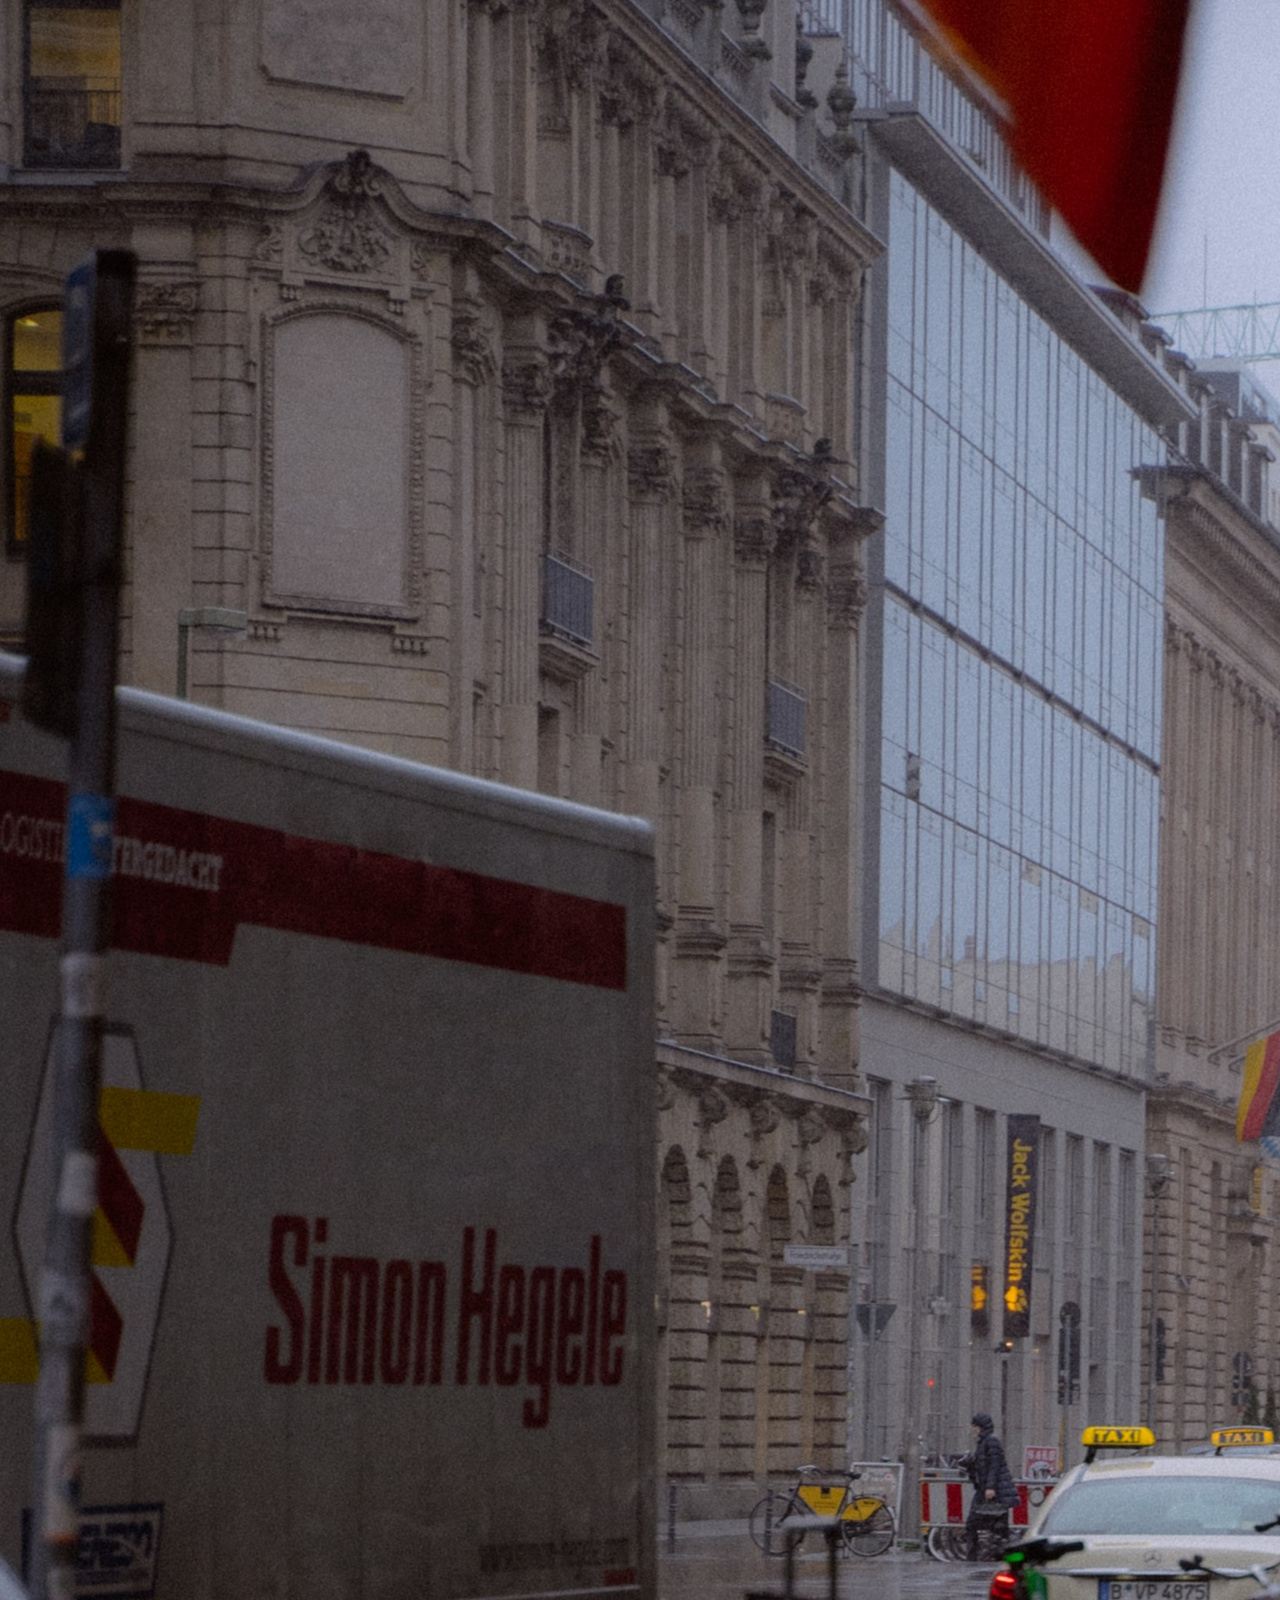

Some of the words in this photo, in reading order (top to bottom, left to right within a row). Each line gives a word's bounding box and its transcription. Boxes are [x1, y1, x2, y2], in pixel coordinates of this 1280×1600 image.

[0, 809, 67, 863] OGISTI
[111, 835, 224, 892] TERGEDACHT
[1011, 1137, 1033, 1188] Jack
[1008, 1193, 1031, 1282] Wolfskin
[264, 1214, 446, 1385] Simon
[455, 1226, 628, 1429] Hegele
[1095, 1429, 1140, 1443] TAXI
[1223, 1432, 1262, 1443] TAXI
[1111, 1584, 1122, 1600] B
[1134, 1584, 1158, 1600] VP
[1161, 1584, 1206, 1600] 4875
